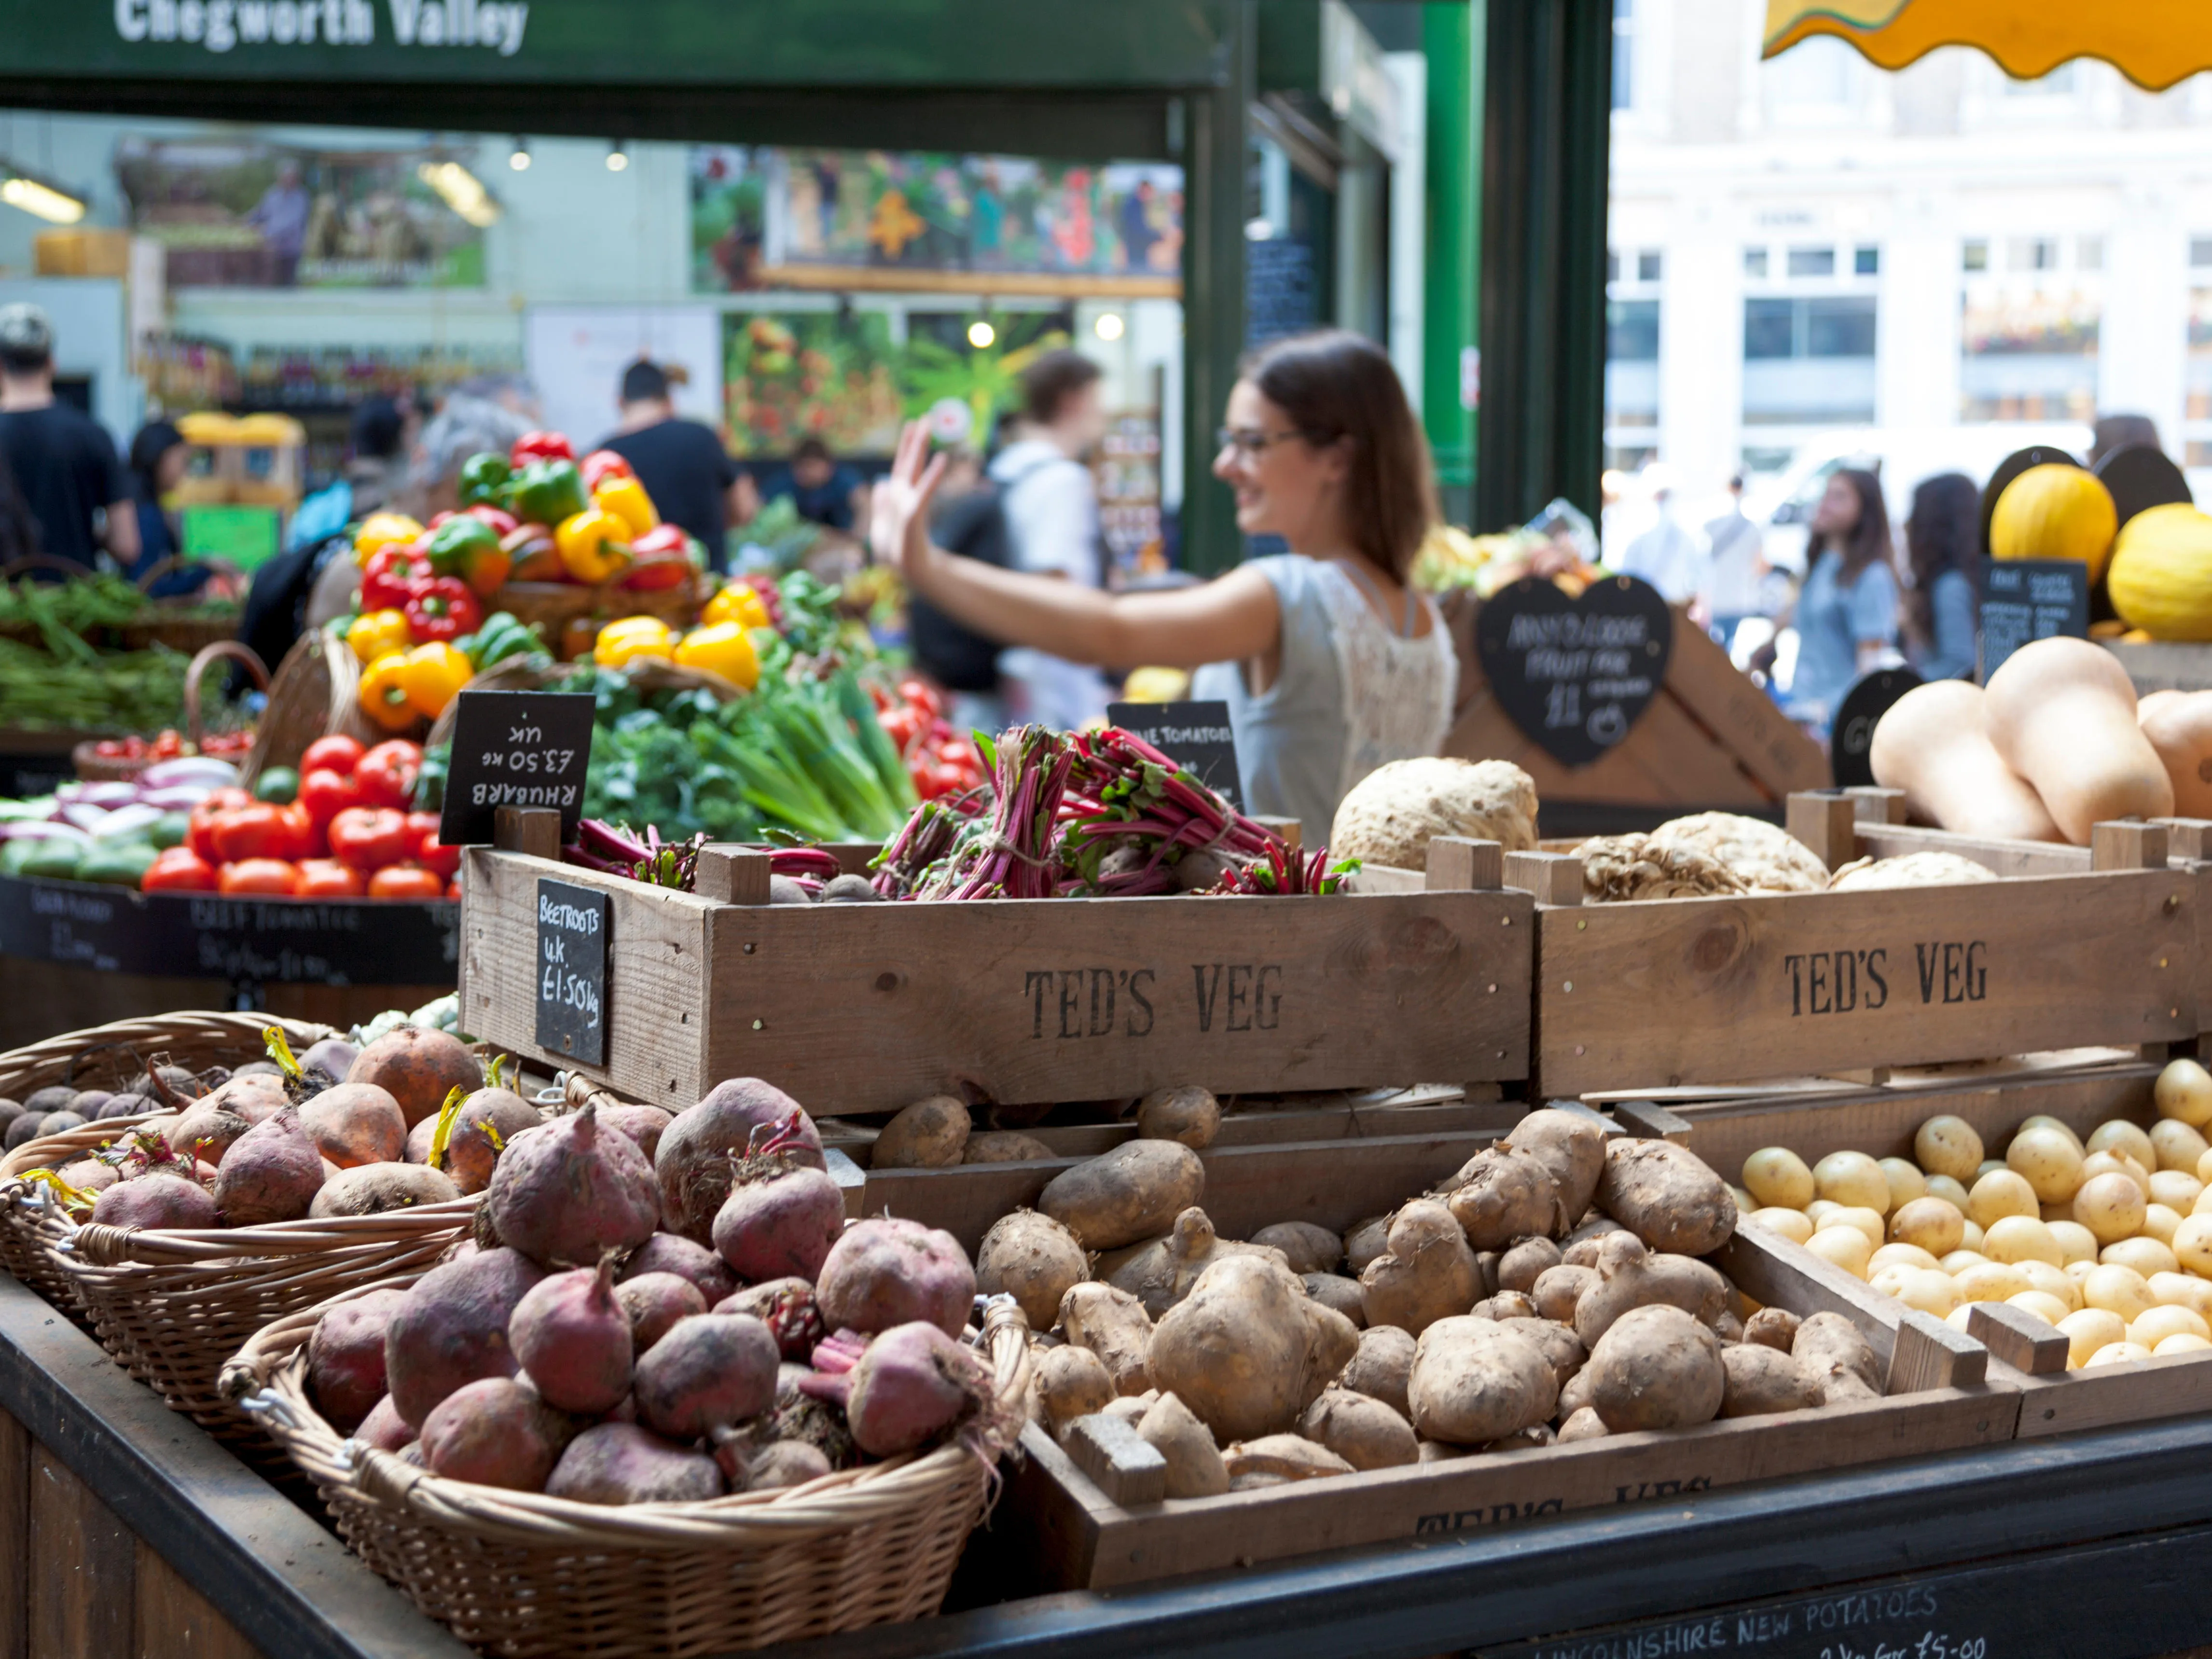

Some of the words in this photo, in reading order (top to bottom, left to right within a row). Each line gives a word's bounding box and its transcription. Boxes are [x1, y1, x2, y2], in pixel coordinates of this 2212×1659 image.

[112, 0, 375, 52] Chegworth
[390, 0, 529, 55] Valley
[508, 726, 541, 744] UK
[509, 749, 575, 774] £3.50
[472, 783, 577, 806] RHUBARB
[539, 895, 599, 935] BEETROOTS
[1024, 968, 1156, 1039] TED'S
[1191, 963, 1283, 1033] VEG
[1785, 948, 1888, 1016] TED'S
[1914, 940, 1988, 1004] VEG
[1738, 1613, 1791, 1645] NEW
[1806, 1589, 1937, 1631] POTATOES
